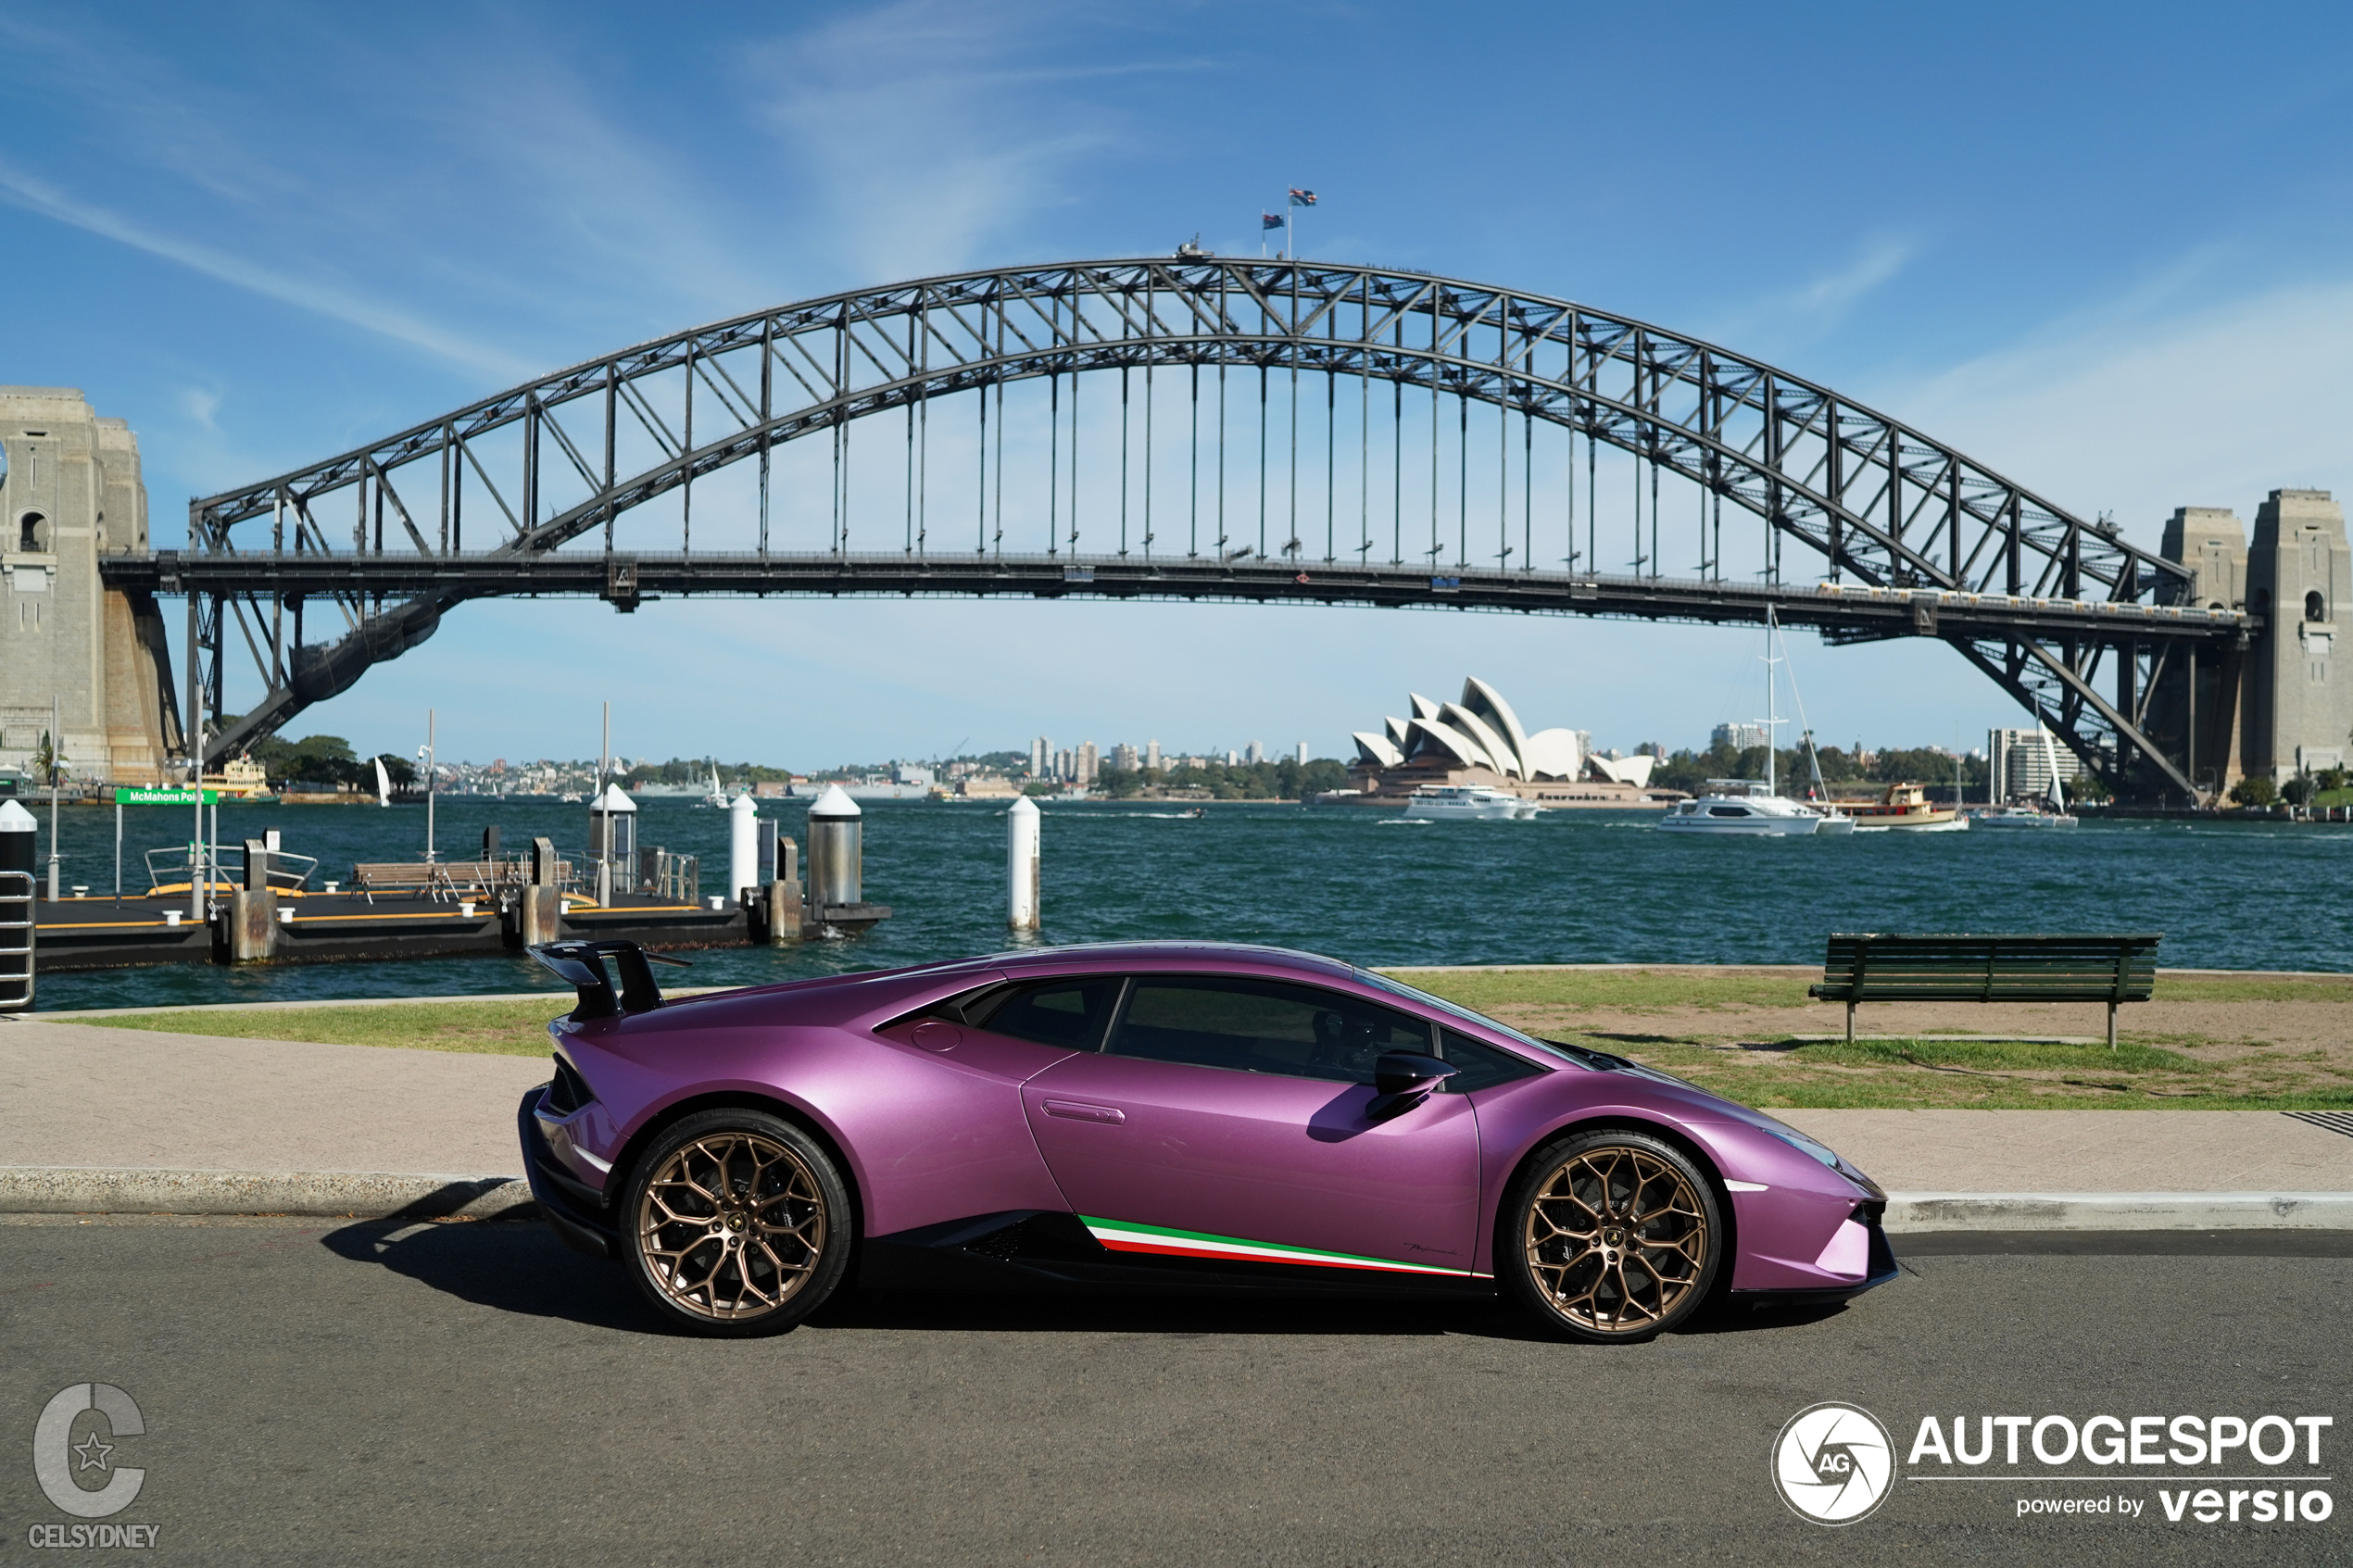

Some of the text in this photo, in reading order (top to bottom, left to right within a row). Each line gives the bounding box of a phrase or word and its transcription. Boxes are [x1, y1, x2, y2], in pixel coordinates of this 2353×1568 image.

[130, 791, 205, 802] McMahons Poit
[1403, 1242, 1464, 1256] Performante
